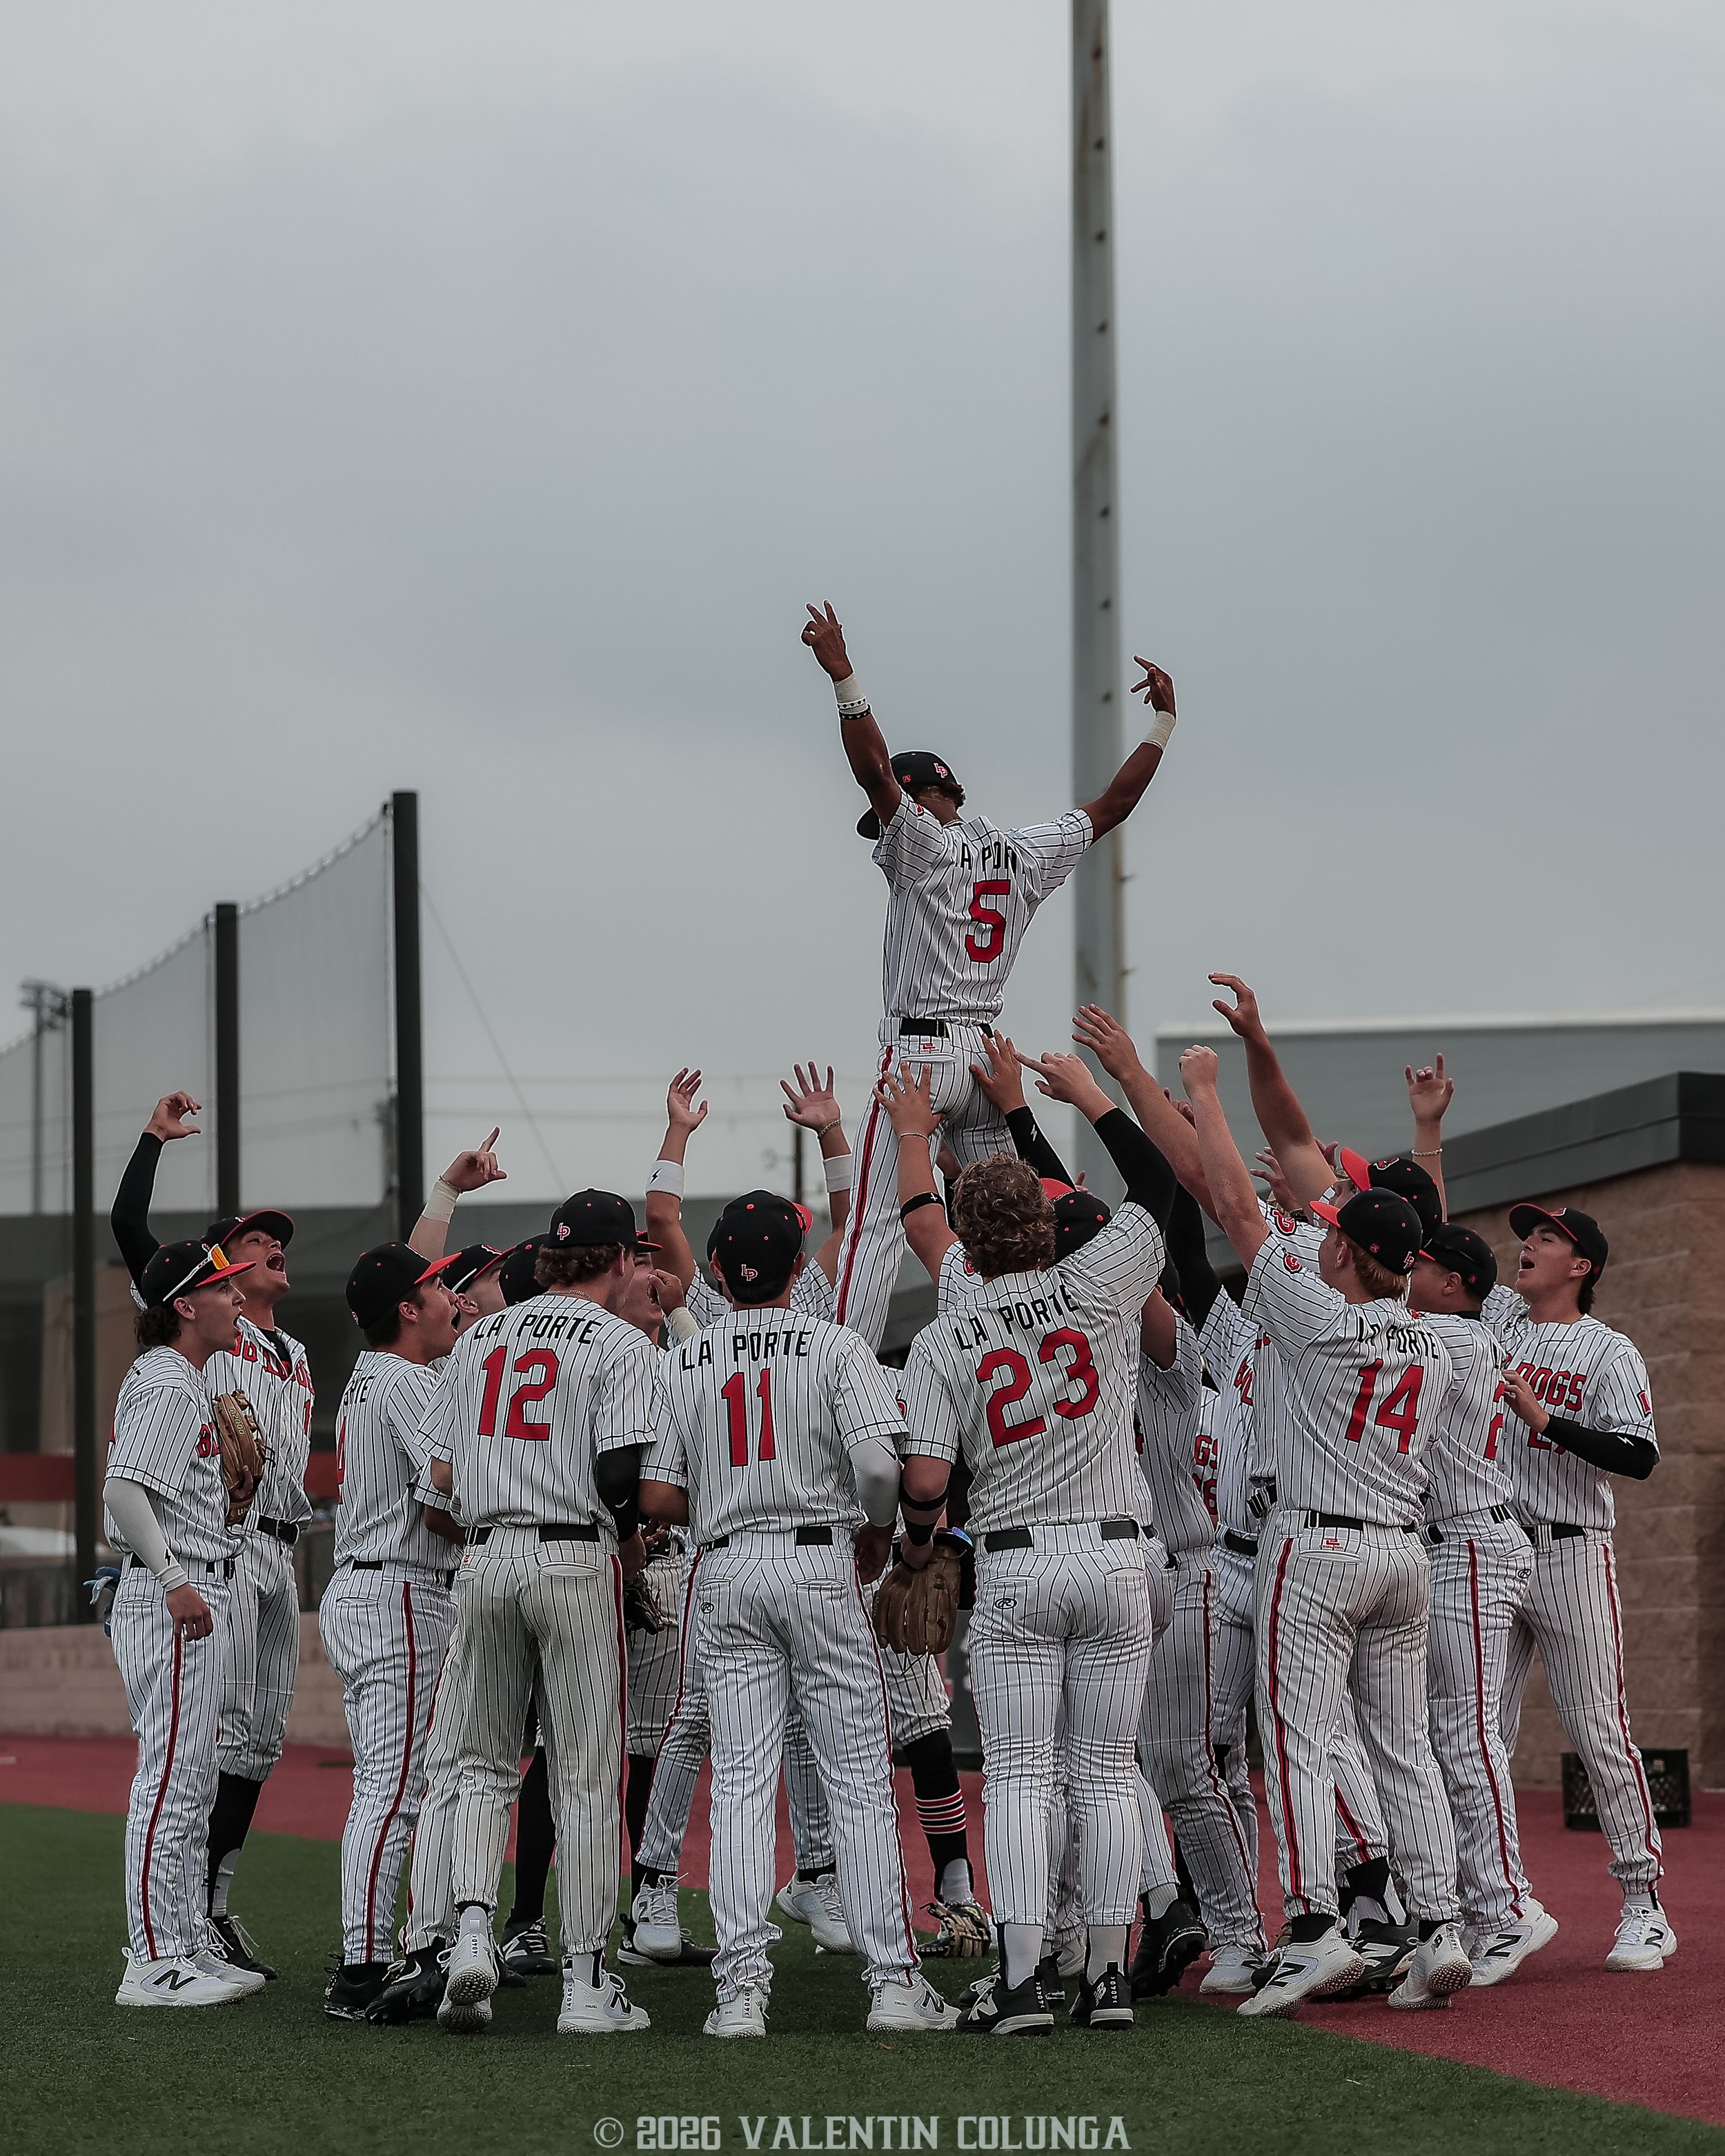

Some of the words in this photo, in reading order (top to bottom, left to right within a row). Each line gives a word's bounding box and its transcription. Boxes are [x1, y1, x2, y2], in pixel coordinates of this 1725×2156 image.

[966, 879, 1010, 964] 5
[473, 1316, 502, 1340] LA
[516, 1314, 603, 1345] PORTE
[681, 1340, 713, 1372] LA
[732, 1329, 813, 1363] PORTE
[954, 1315, 989, 1351] LA
[997, 1284, 1081, 1337] PORTE
[1386, 1324, 1439, 1359] PORTE
[477, 1345, 560, 1441] 12
[721, 1367, 777, 1467] 11
[976, 1327, 1101, 1449] 23
[1343, 1356, 1425, 1455] 14
